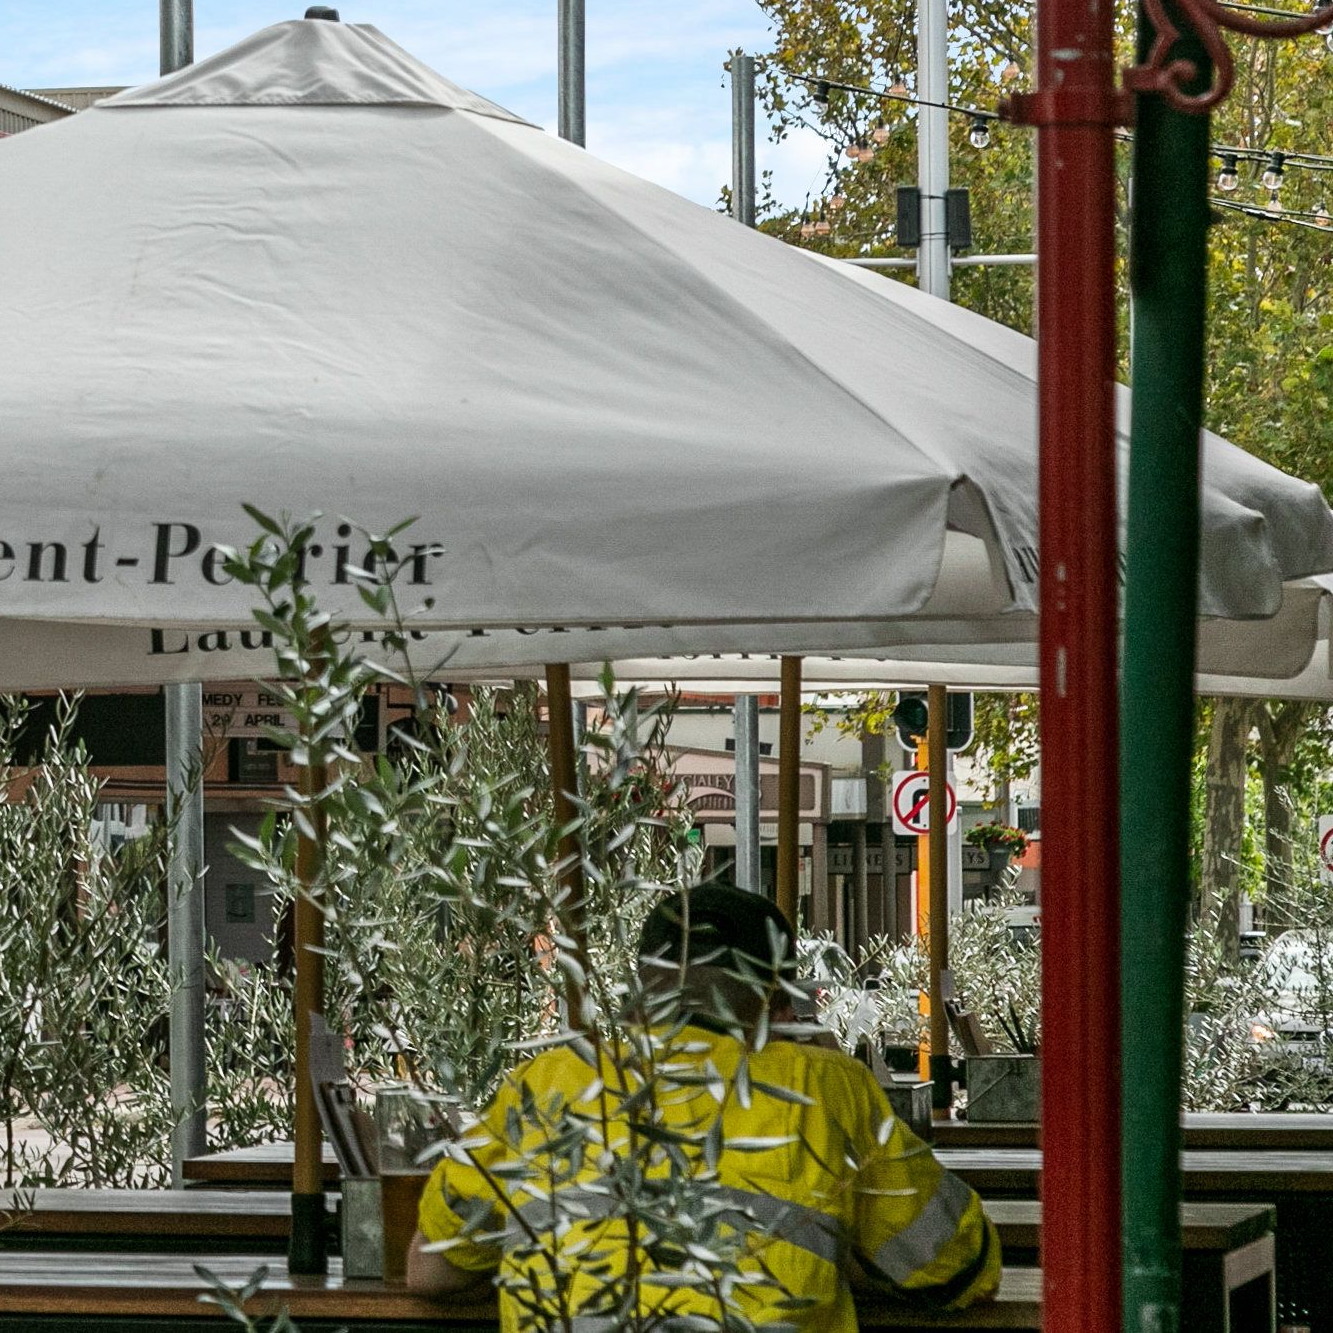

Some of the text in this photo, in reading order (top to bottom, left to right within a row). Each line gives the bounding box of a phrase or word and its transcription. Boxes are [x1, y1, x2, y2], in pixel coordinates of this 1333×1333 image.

[203, 694, 285, 705] MEDY FES
[244, 714, 286, 727] APRIL
